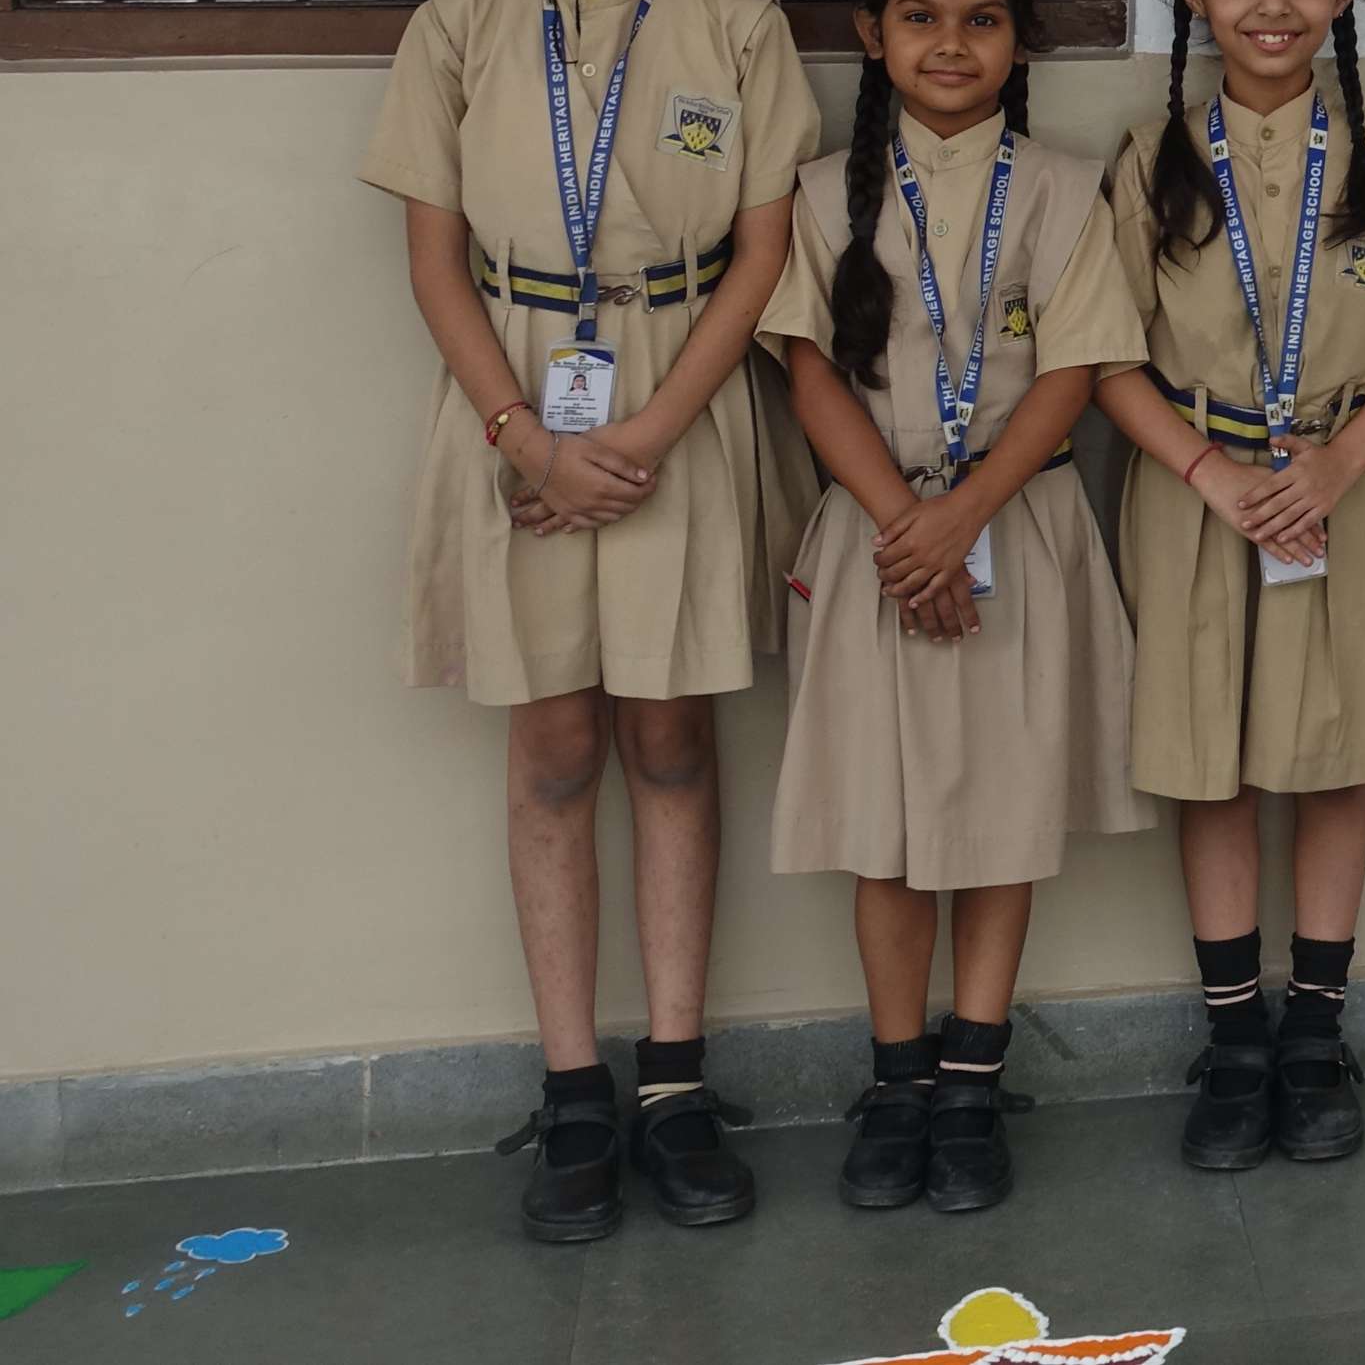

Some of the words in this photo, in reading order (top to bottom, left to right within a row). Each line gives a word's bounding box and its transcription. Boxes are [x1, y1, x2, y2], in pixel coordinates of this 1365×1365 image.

[553, 86, 574, 163] HERITAGE
[589, 153, 605, 206] INDIAN
[597, 74, 623, 148] HERITAGE
[1210, 108, 1220, 133] THE
[562, 167, 582, 221] INDIAN
[1218, 169, 1239, 227] SCHOOL
[1305, 159, 1322, 216] SCHOOL
[572, 224, 588, 255] THE
[1231, 229, 1257, 303] HERITAGE
[1295, 220, 1315, 294] HERITAGE
[963, 361, 979, 390] THE
[990, 173, 1009, 225] SCHOOL
[1288, 297, 1305, 349] INDIAN
[941, 381, 955, 410] THE
[1283, 353, 1297, 383] THE
